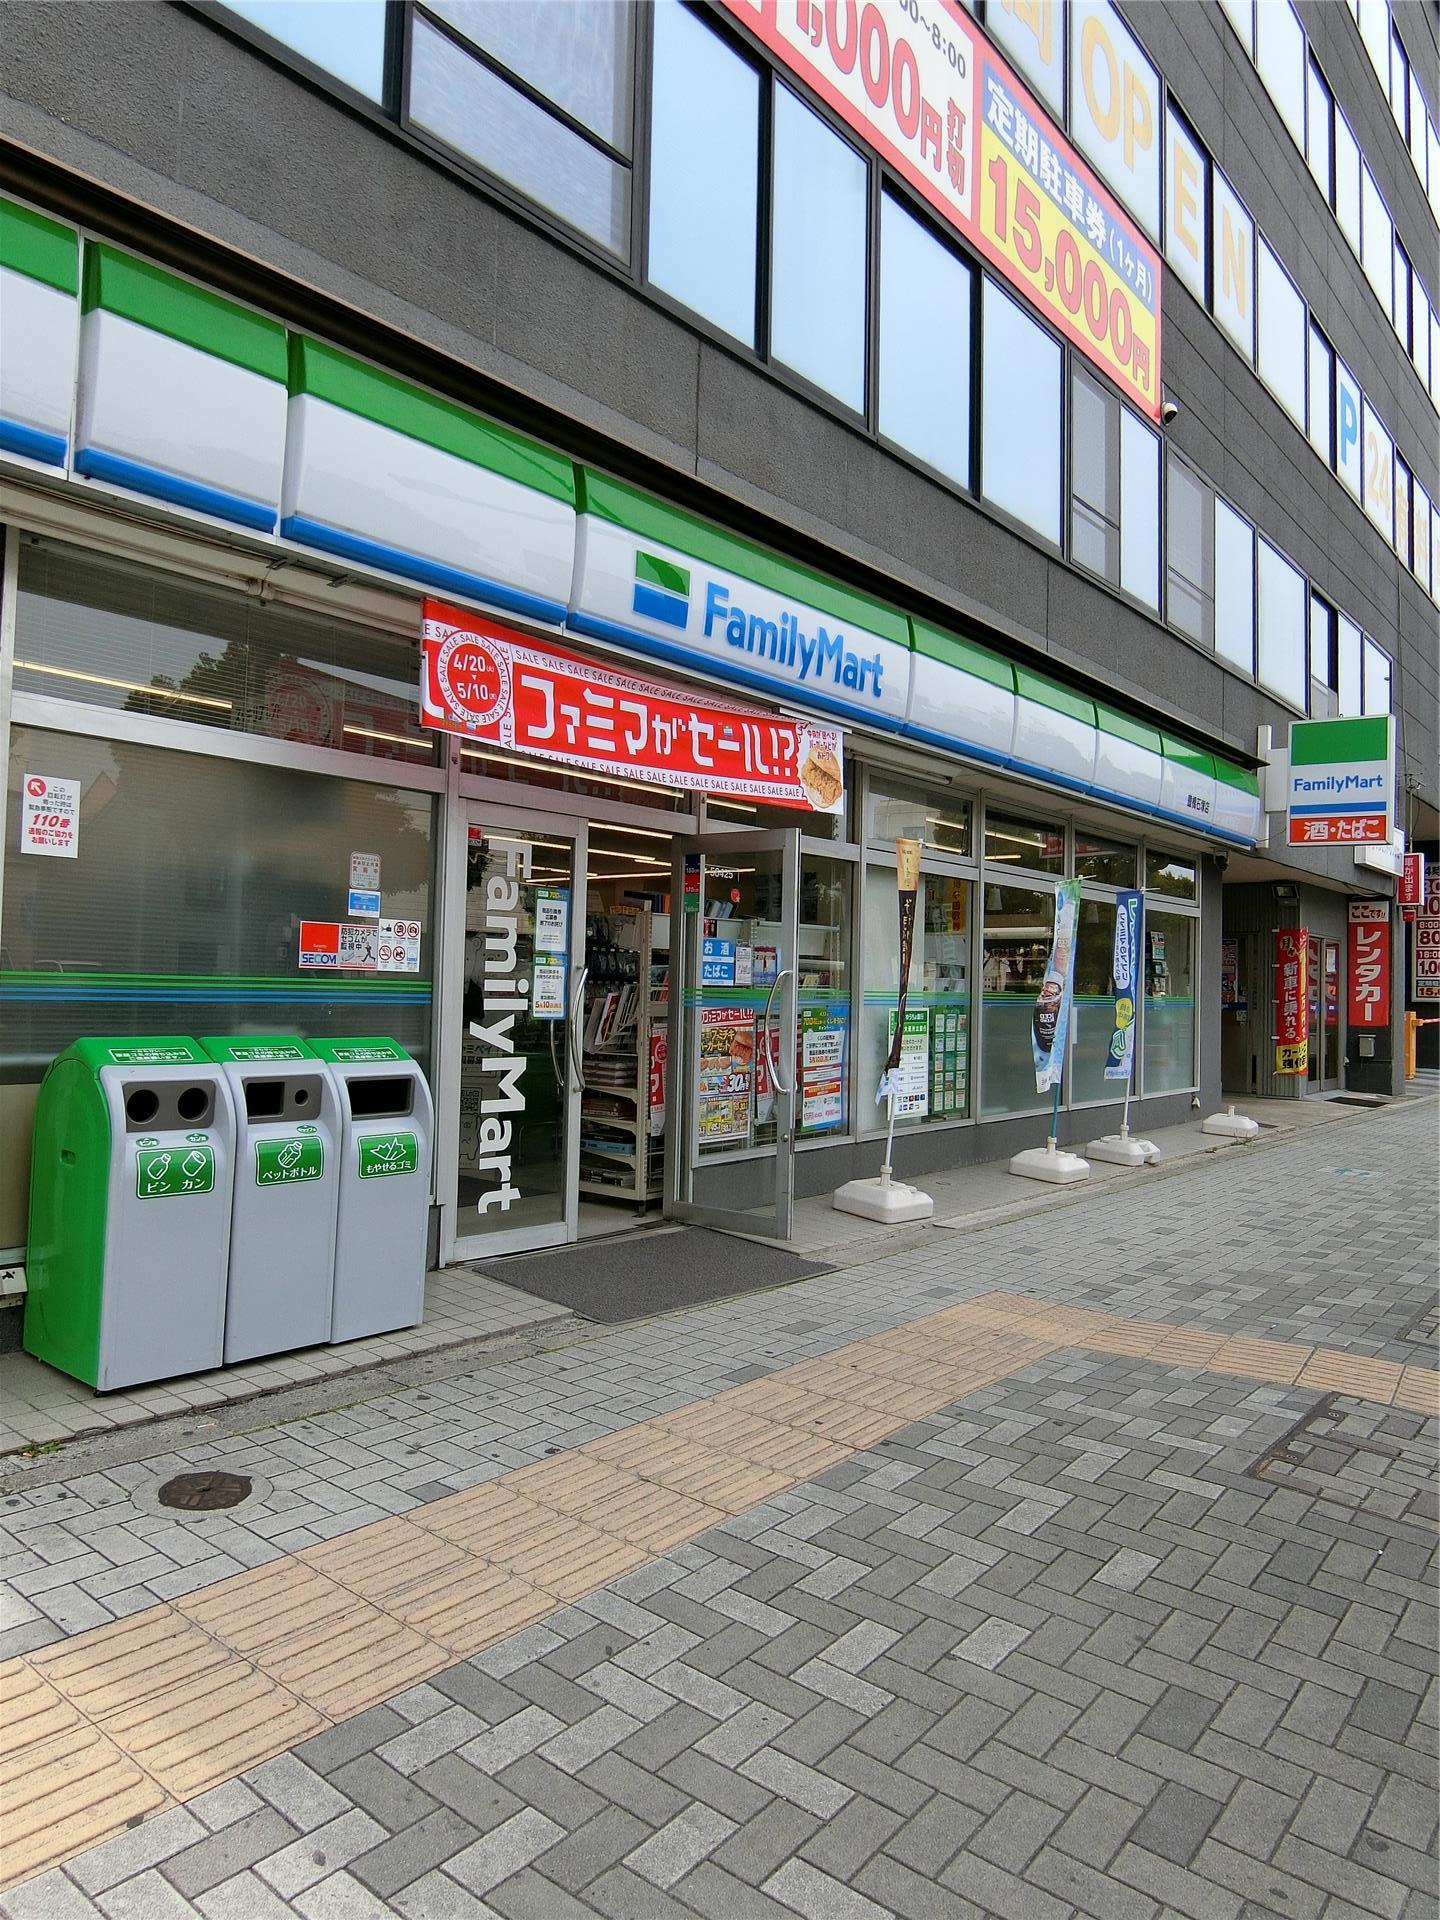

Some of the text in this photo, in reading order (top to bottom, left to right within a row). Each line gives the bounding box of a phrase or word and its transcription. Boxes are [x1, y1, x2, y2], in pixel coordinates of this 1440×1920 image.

[946, 97, 966, 196] 打切
[1081, 15, 1246, 320] OPEN
[988, 155, 1150, 391] 15,000円
[703, 581, 884, 698] FamilyMart
[515, 650, 540, 665] SALE
[541, 658, 565, 672] SALE
[567, 664, 589, 679] SALE
[592, 671, 614, 685] SALE
[616, 677, 639, 691] SALE
[639, 683, 660, 696] SALE
[662, 689, 682, 701] SALE
[599, 764, 621, 775] SALE
[623, 768, 644, 779] SALE
[647, 771, 667, 783] SALE
[669, 775, 688, 785] SALE
[690, 778, 709, 788] SALE
[711, 780, 729, 790] SALE
[731, 782, 748, 792] SALE
[749, 784, 766, 794] SALE
[767, 786, 783, 796] SALE
[785, 787, 800, 797] SALE
[1293, 774, 1383, 793] FamilyMart
[47, 792, 73, 801] 回転灯が
[32, 814, 71, 828] 110番
[1303, 818, 1379, 840] 酒・たばこ
[28, 827, 73, 839] 通報のご協力を
[31, 836, 70, 847] お願いします
[1404, 857, 1414, 901] 車が出ます
[341, 927, 378, 937] 防犯カメラで
[341, 935, 368, 943] セコムが
[341, 942, 362, 951] 監視中
[302, 953, 337, 965] SECOM
[704, 964, 729, 978] たばこ
[1355, 926, 1381, 1021] レンタカー
[1283, 960, 1300, 1042] 新車に乗れる。
[469, 839, 532, 1215] FamilyMart
[262, 1166, 317, 1180] ペットボトル
[366, 1160, 412, 1174] もやせるゴミ
[147, 1178, 206, 1193] ビン カン
